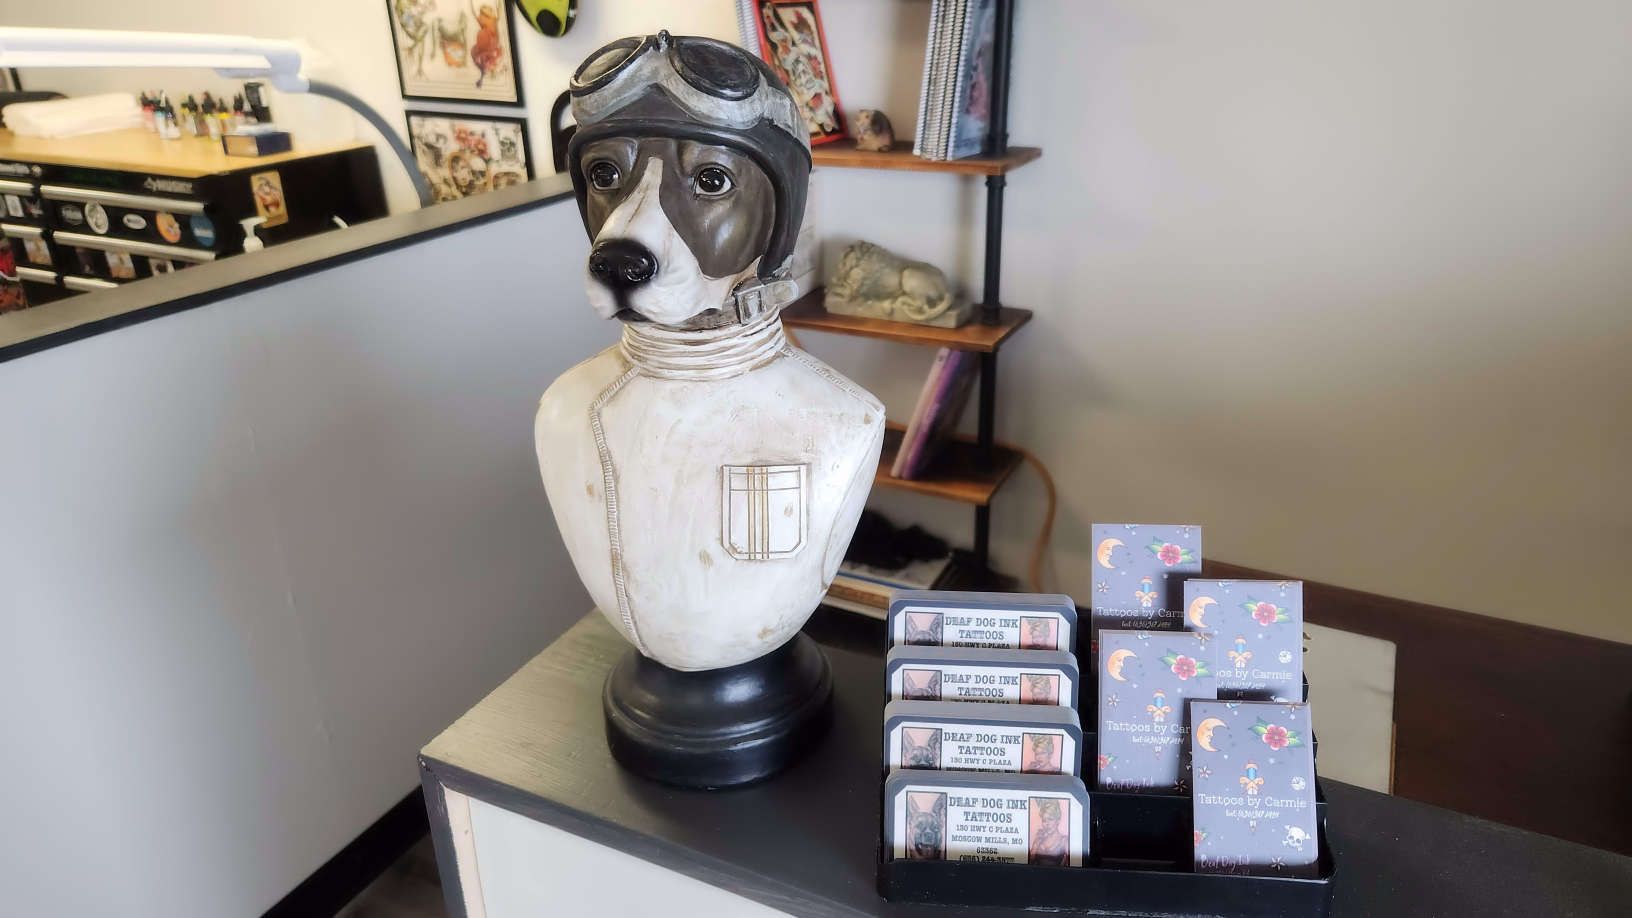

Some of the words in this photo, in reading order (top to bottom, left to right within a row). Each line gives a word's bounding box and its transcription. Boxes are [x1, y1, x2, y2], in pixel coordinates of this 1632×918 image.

[1096, 606, 1139, 618] Tattoos
[1142, 606, 1155, 619] by
[1157, 608, 1184, 618] Carm
[945, 616, 973, 626] DEAF
[976, 617, 996, 627] DOG
[999, 618, 1019, 628] INK
[958, 629, 1005, 640] TATTOOS
[943, 673, 972, 683] DEAF
[975, 674, 996, 684] DOG
[998, 675, 1018, 685] INK
[1235, 668, 1248, 681] by
[1252, 669, 1293, 680] Carmie
[957, 686, 1004, 697] TATTOOS
[1105, 720, 1150, 733] Tattoos
[1153, 722, 1168, 735] by
[1169, 723, 1191, 734] Car
[943, 731, 973, 742] DEAF
[976, 733, 998, 743] DOG
[1000, 734, 1021, 745] INK
[958, 745, 1006, 756] TATTOOS
[964, 757, 980, 765] HWY
[988, 758, 1012, 766] PLAZA
[948, 796, 978, 807] DEAF
[981, 797, 1003, 809] DOG
[1005, 799, 1028, 810] INK
[1198, 793, 1244, 806] Tattoos
[1247, 795, 1261, 809] by
[1264, 796, 1307, 808] Carmie
[963, 811, 1013, 823] TATTOOS
[970, 825, 987, 833] HWY
[995, 826, 1019, 834] PLAZA
[951, 834, 983, 843] MOSCOW
[1011, 837, 1024, 845] MO
